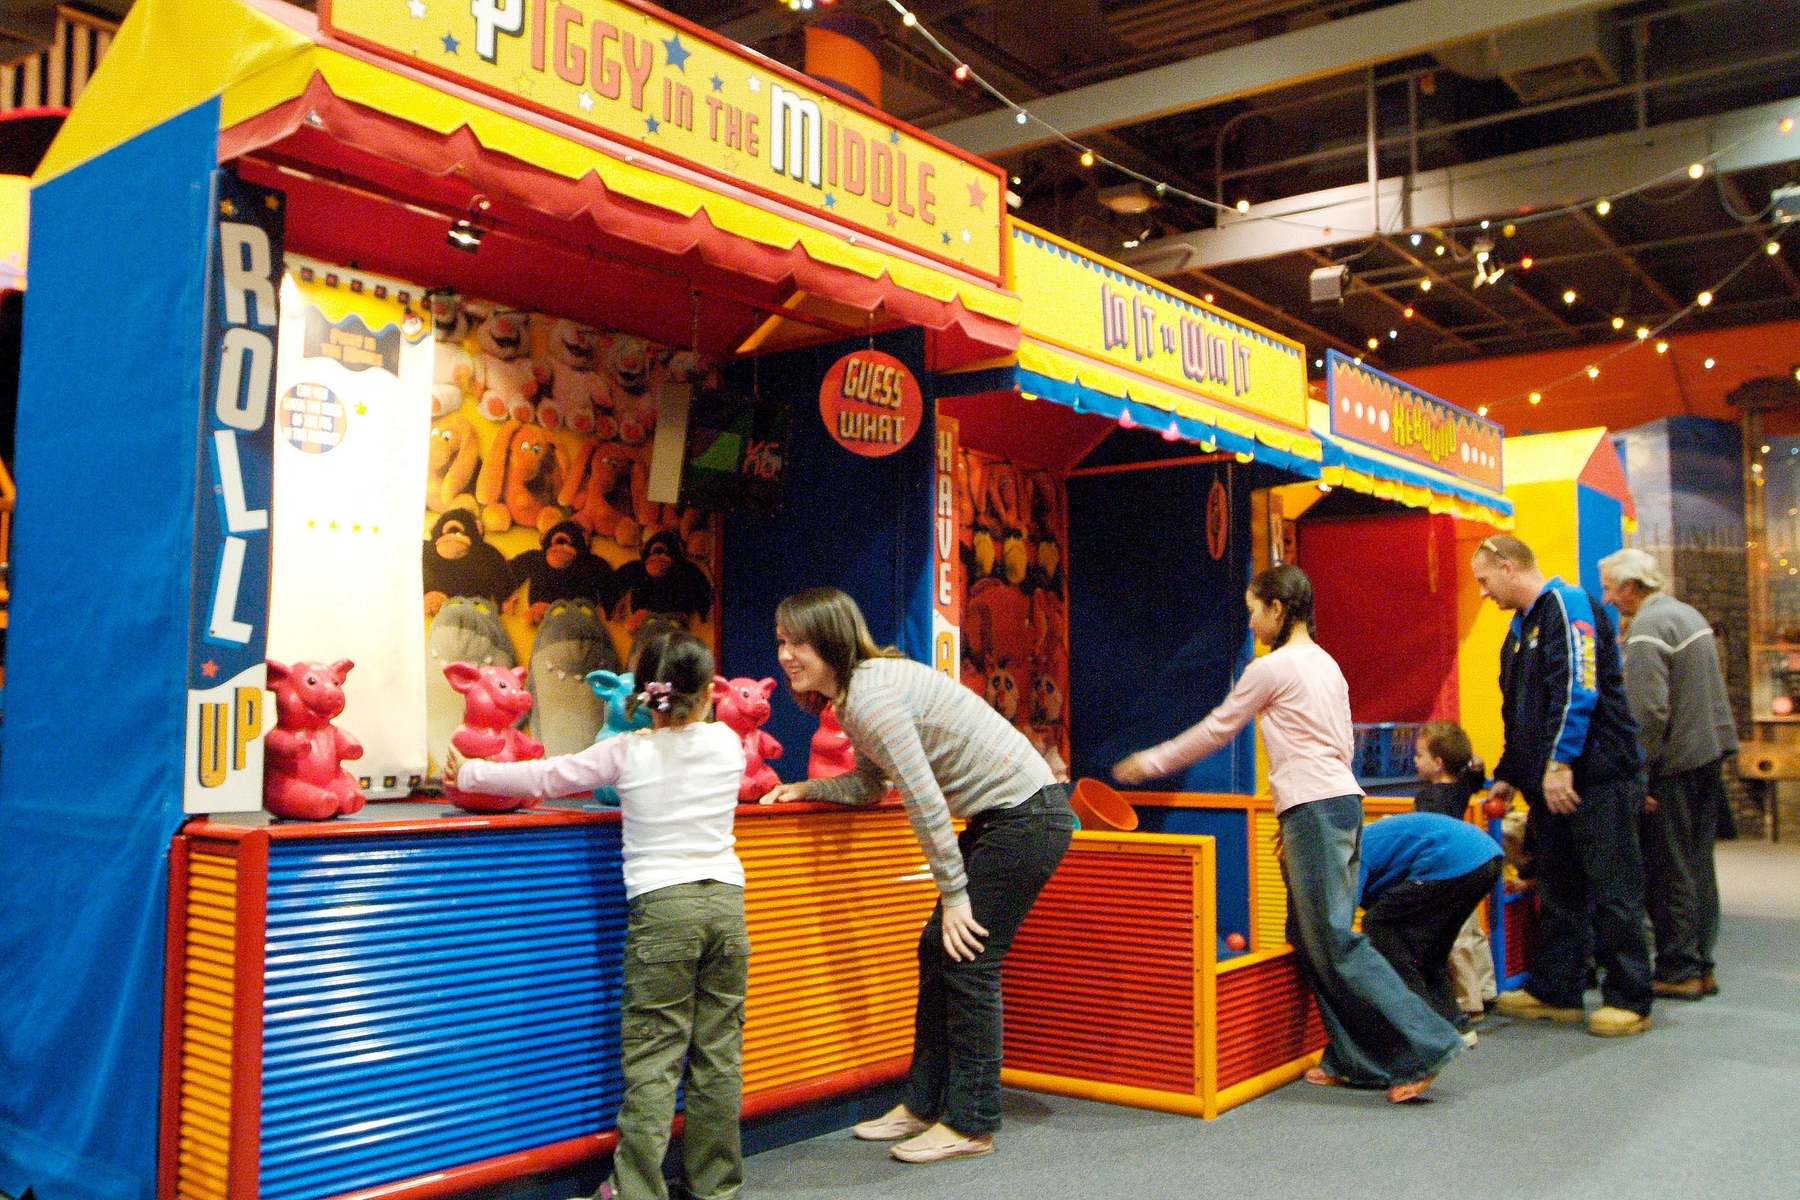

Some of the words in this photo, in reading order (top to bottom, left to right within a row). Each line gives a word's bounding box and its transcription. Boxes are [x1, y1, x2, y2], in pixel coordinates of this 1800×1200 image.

[471, 0, 653, 110] PIGGY
[663, 78, 692, 132] IN
[706, 95, 760, 157] THE
[770, 83, 935, 226] MIDDLE
[842, 356, 905, 409] GUESS
[1133, 296, 1155, 361] IT
[1232, 336, 1252, 396] IT
[213, 222, 278, 647] ROLL
[837, 410, 905, 445] WHAT
[936, 429, 954, 606] HAVE
[197, 686, 263, 789] UP
